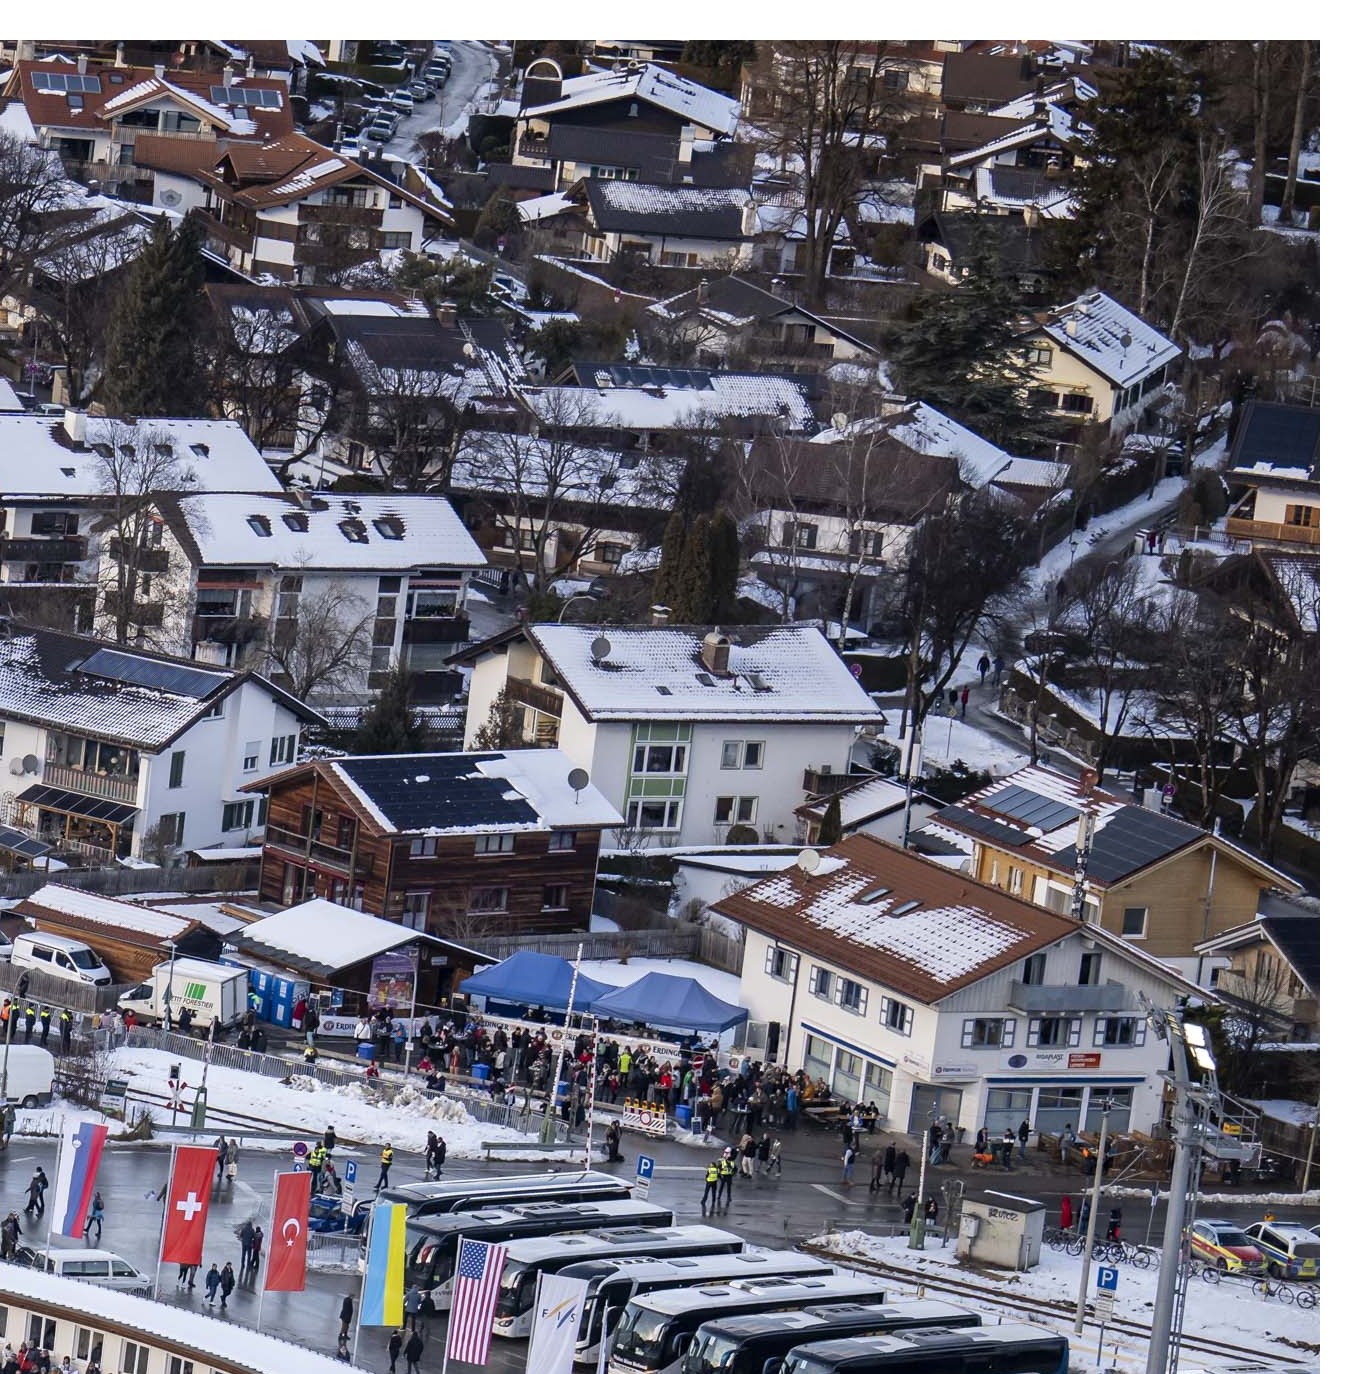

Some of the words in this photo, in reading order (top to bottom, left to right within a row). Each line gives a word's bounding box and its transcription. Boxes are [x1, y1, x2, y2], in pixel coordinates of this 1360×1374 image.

[183, 998, 214, 1009] FORESTIER
[336, 1022, 357, 1031] ERDIN
[347, 1162, 355, 1179] P
[1101, 1270, 1114, 1286] P
